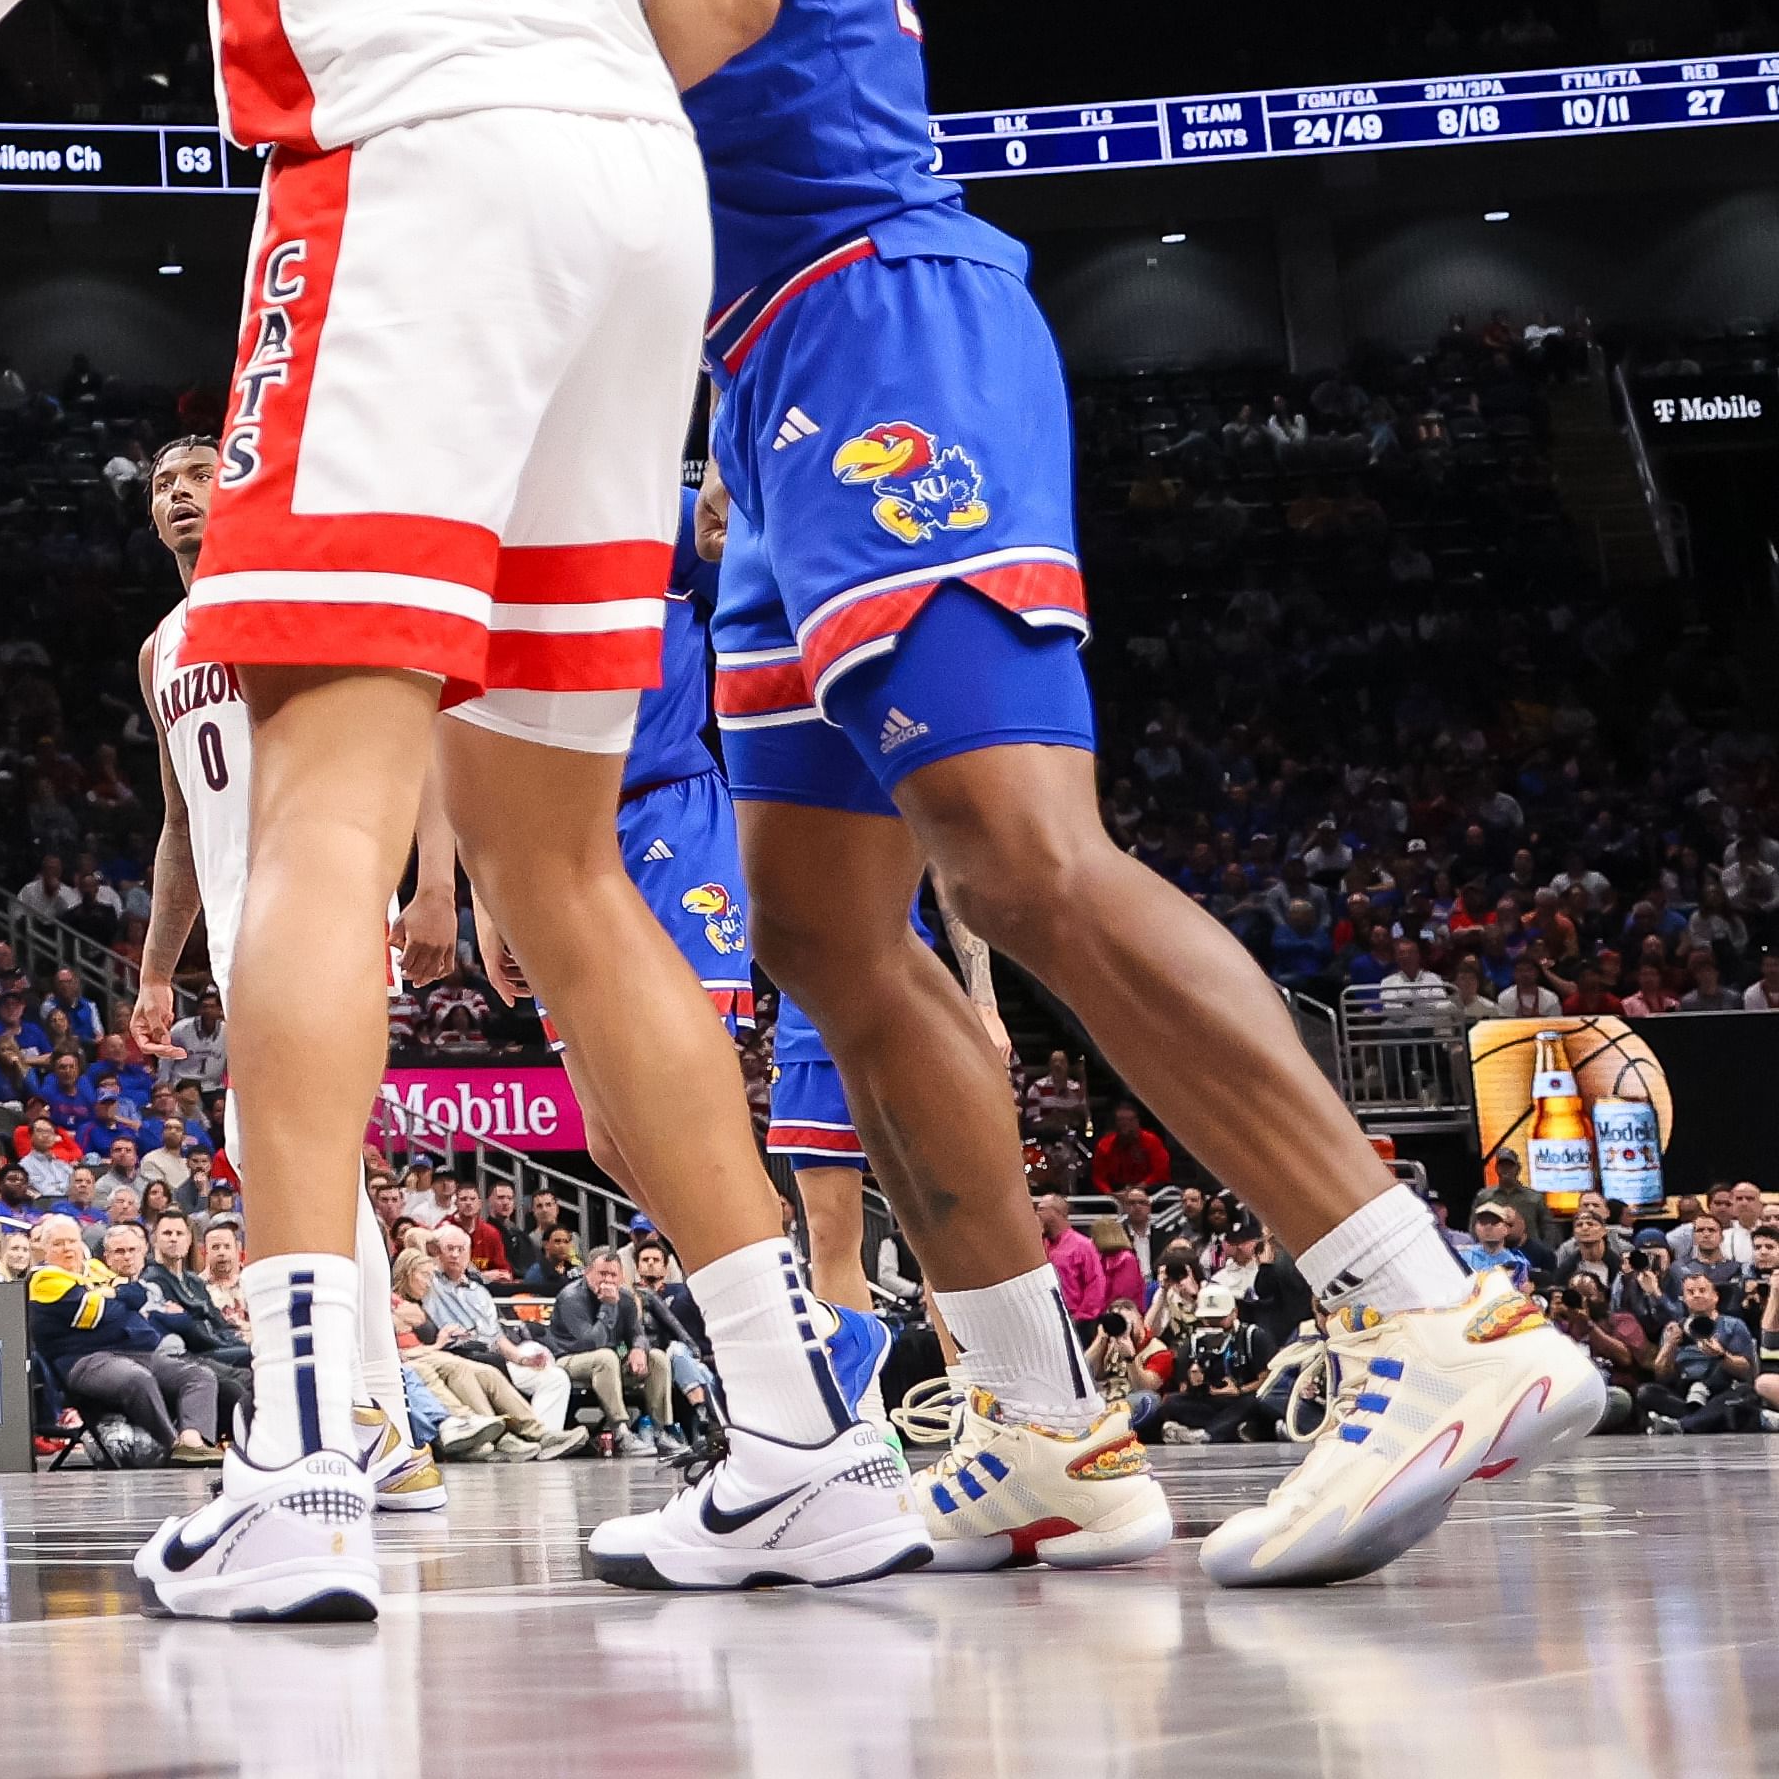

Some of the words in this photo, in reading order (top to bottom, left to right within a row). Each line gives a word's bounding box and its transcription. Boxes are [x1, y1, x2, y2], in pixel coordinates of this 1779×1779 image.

[1297, 88, 1378, 109] FGM/FGA
[1424, 78, 1505, 100] 3PM/3PA
[1561, 68, 1641, 90] FTM/FTA
[1681, 63, 1719, 81] REB
[1758, 59, 1779, 76] AS
[994, 115, 1029, 132] BLK
[1080, 109, 1114, 126] FLS
[1182, 103, 1242, 125] TEAM
[1293, 113, 1383, 147] 24/49
[1437, 104, 1500, 138] 8/18
[1562, 94, 1631, 127] 10/11
[1686, 89, 1725, 117] 27
[1005, 140, 1028, 166] 0
[1182, 128, 1248, 151] STATS
[66, 144, 102, 171] Ch
[176, 146, 212, 173] 63
[219, 239, 307, 489] CATS
[1653, 398, 1675, 423] T
[1679, 394, 1762, 422] Mobile
[911, 474, 948, 504] KU
[160, 662, 247, 732] ARIZON
[198, 721, 229, 792] 0
[379, 1083, 558, 1136] Mobile
